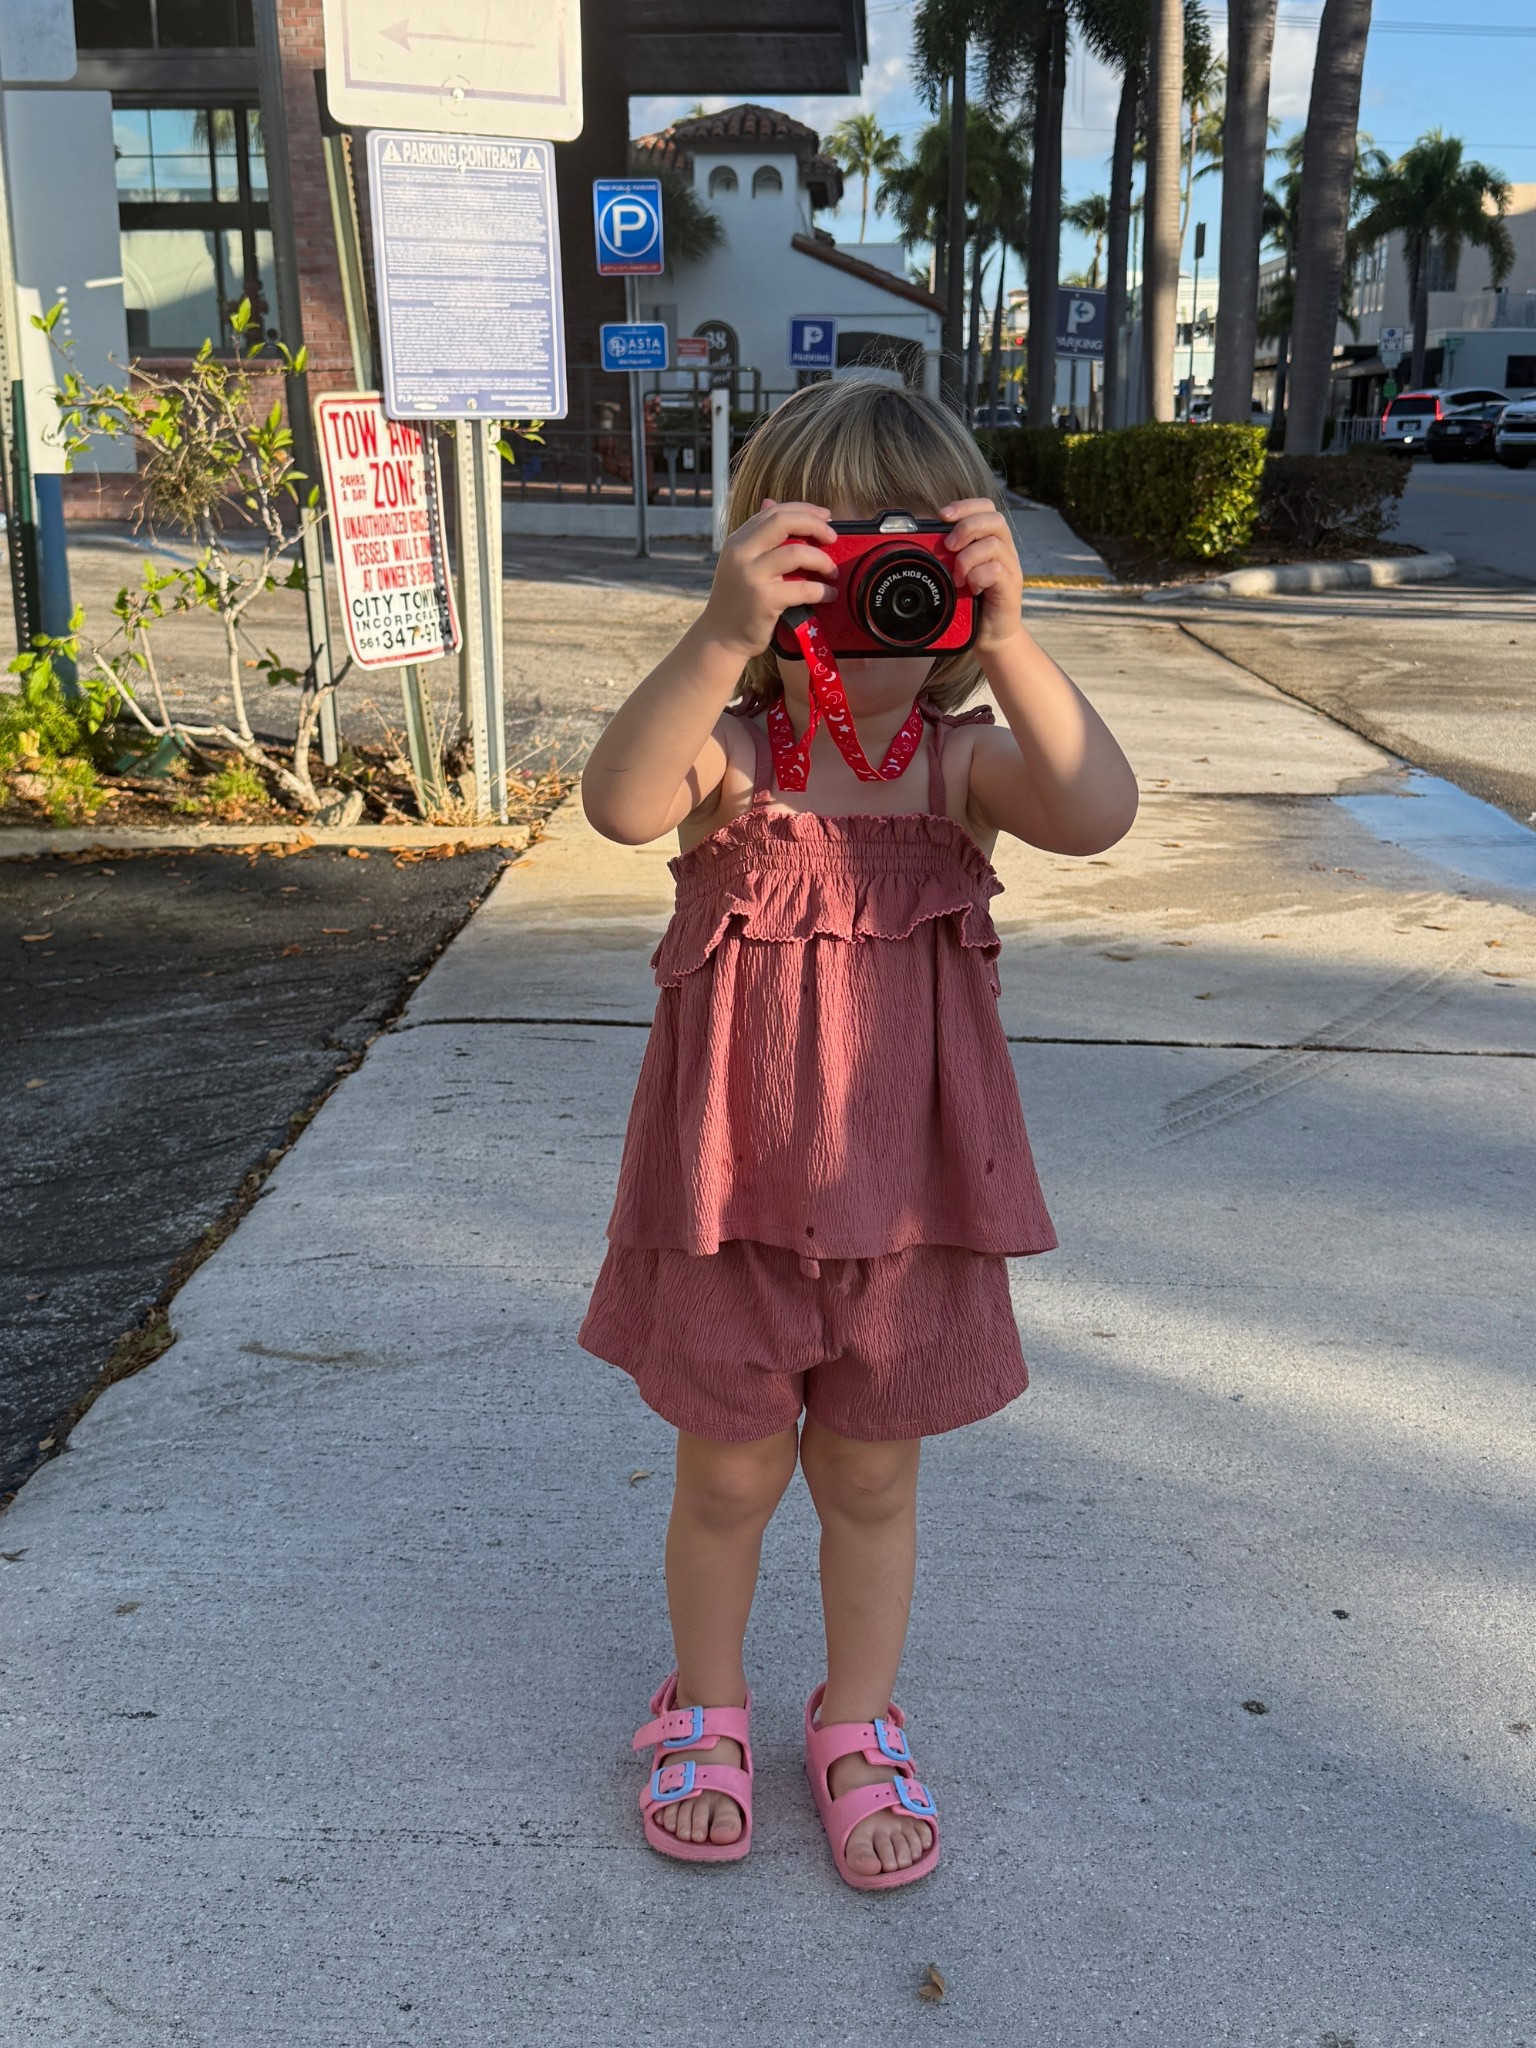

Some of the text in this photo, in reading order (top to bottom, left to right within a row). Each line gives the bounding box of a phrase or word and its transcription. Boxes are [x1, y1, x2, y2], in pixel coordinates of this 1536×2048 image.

[402, 142, 522, 169] PARKING CONTRACT
[612, 205, 647, 248] P
[1067, 300, 1096, 334] P
[629, 338, 661, 350] ASTA
[803, 326, 824, 351] P
[328, 410, 379, 460] TOW
[369, 460, 417, 508] ZONE
[343, 512, 408, 540] UNAUTHORIZED
[352, 541, 390, 566] VESSELS
[392, 537, 414, 562] WILL
[363, 569, 373, 592] AT
[377, 565, 416, 591] OWNER'S
[875, 594, 882, 607] HD
[902, 570, 921, 579] KIDS
[921, 575, 940, 606] CAMERA
[352, 594, 394, 617] CITY
[360, 637, 381, 649] 561
